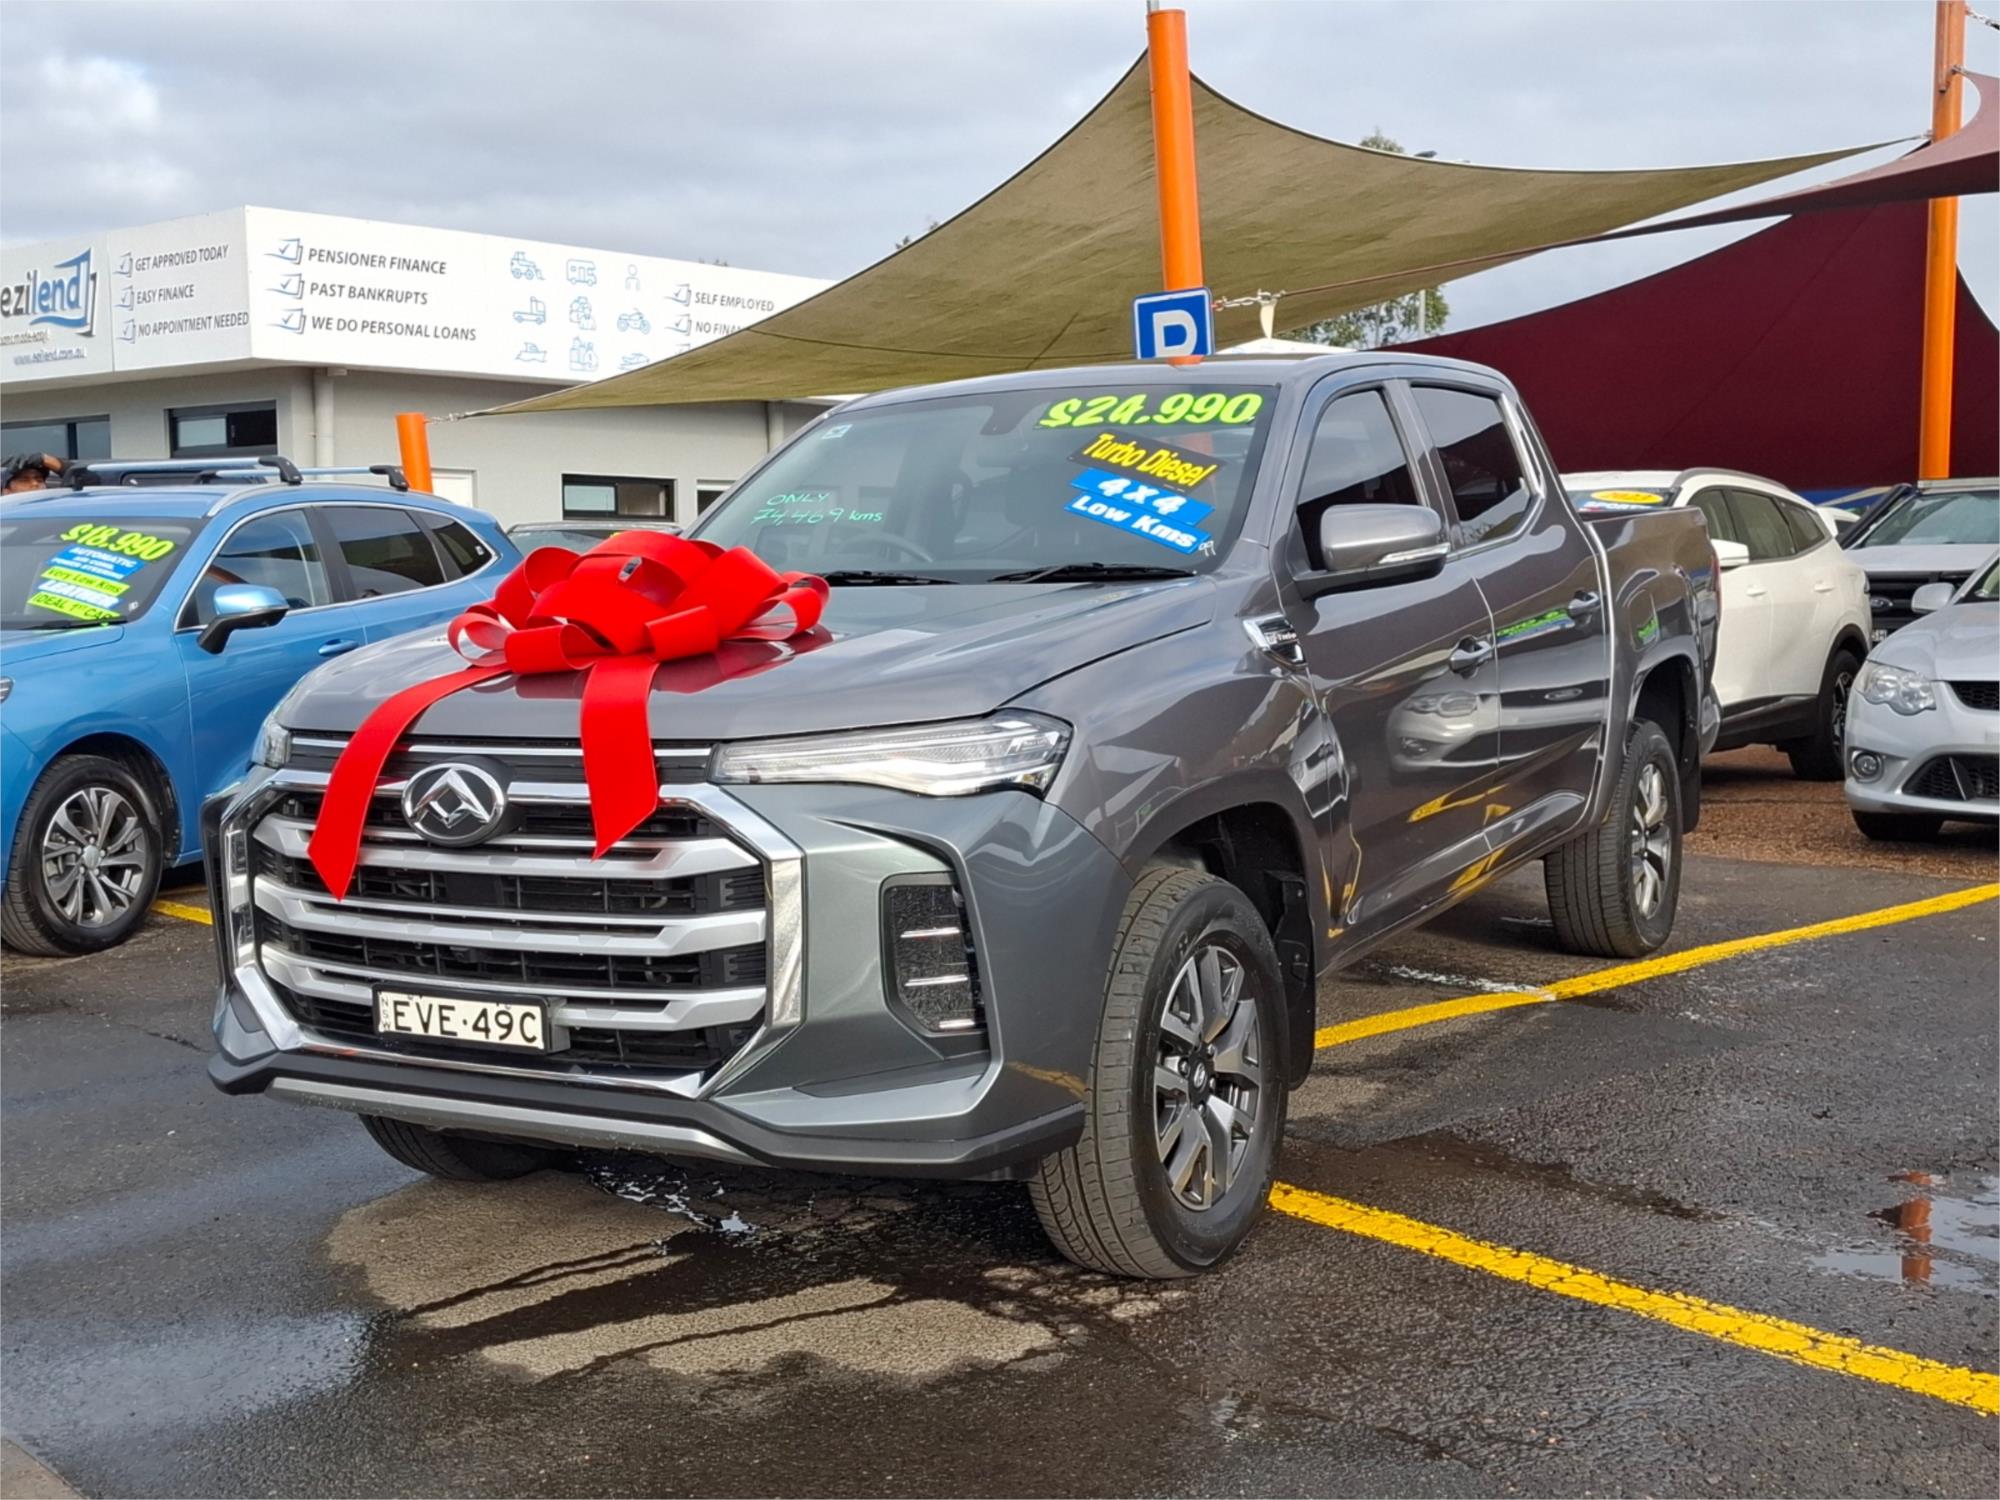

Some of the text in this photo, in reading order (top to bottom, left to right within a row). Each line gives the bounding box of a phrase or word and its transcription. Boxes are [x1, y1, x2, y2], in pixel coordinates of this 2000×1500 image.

[135, 245, 229, 272] GET APPROVED TODAY
[308, 248, 447, 275] PENSIONER FINANCE
[136, 285, 195, 304] EASY FINANCE
[310, 282, 428, 305] PAST BANKRUPTS
[695, 292, 774, 312] SELF EMPLOYED
[138, 311, 250, 337] NO APPOINTMENT NEEDED
[311, 316, 477, 341] WE DO PERSONAL LOANS
[696, 321, 741, 335] NO FINA
[1083, 433, 1218, 487] Turbo Diesel
[766, 492, 830, 506] ONLY
[848, 510, 883, 522] kms
[1071, 496, 1198, 548] Low Kms
